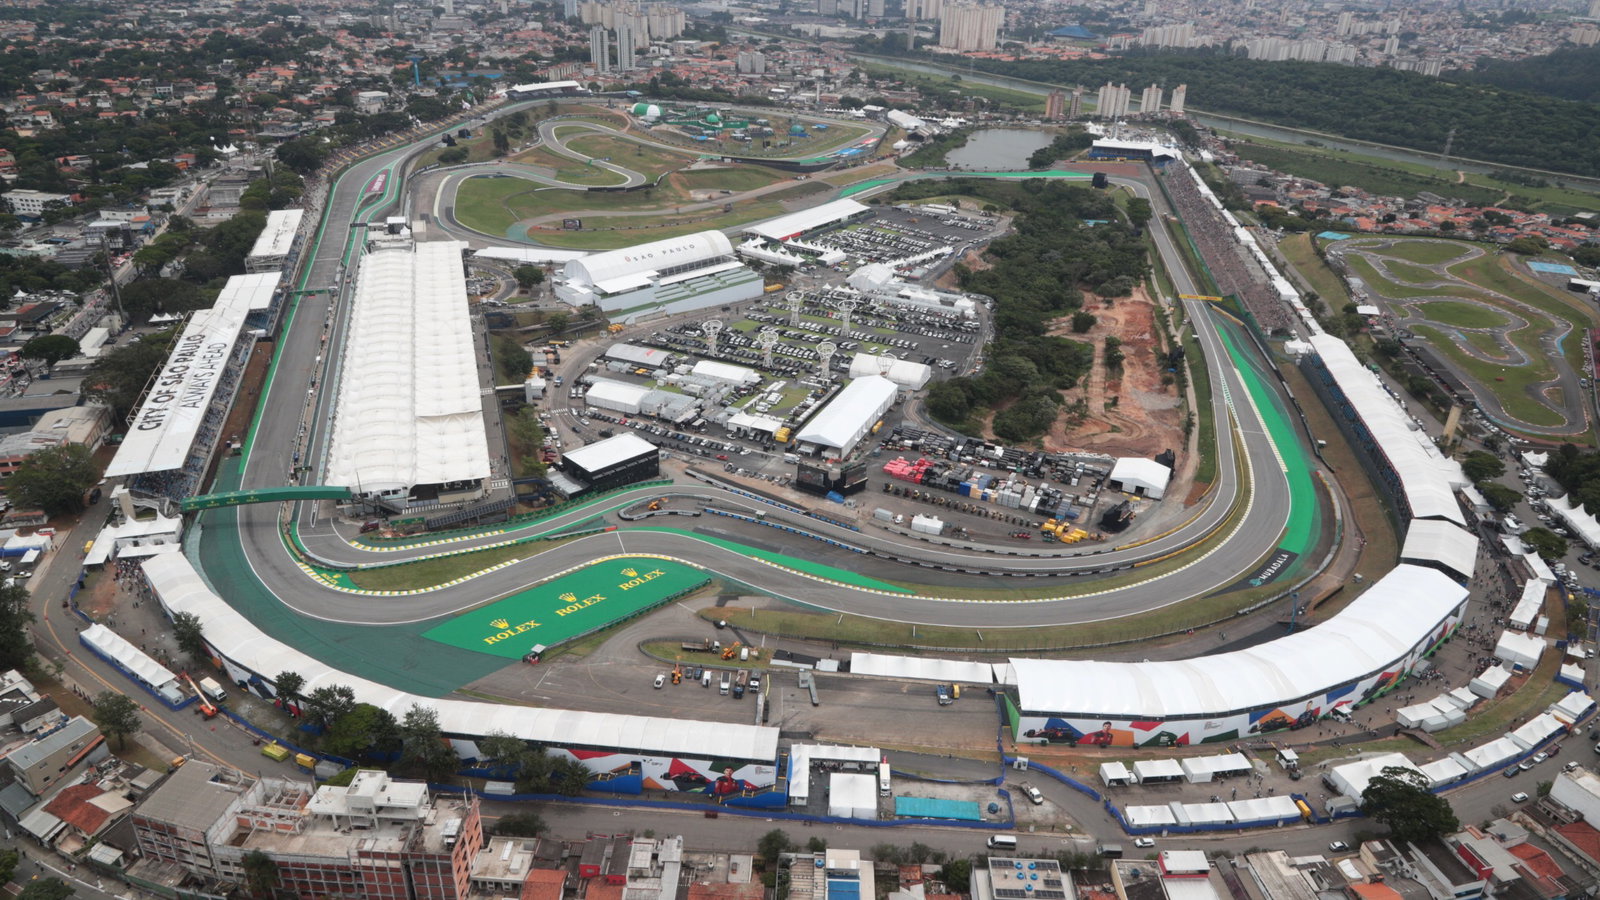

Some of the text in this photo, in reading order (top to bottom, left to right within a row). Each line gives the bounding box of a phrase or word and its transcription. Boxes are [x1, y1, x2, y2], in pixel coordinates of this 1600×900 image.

[662, 244, 695, 255] PAULO
[138, 334, 205, 431] CITY OF SÃO PAULO
[180, 342, 228, 409] ALWAYS AHEAD
[618, 568, 666, 591] ROLEX
[1259, 553, 1289, 580] MUBADALA
[555, 593, 607, 617] ROLEX
[483, 619, 542, 646] ROLEX
